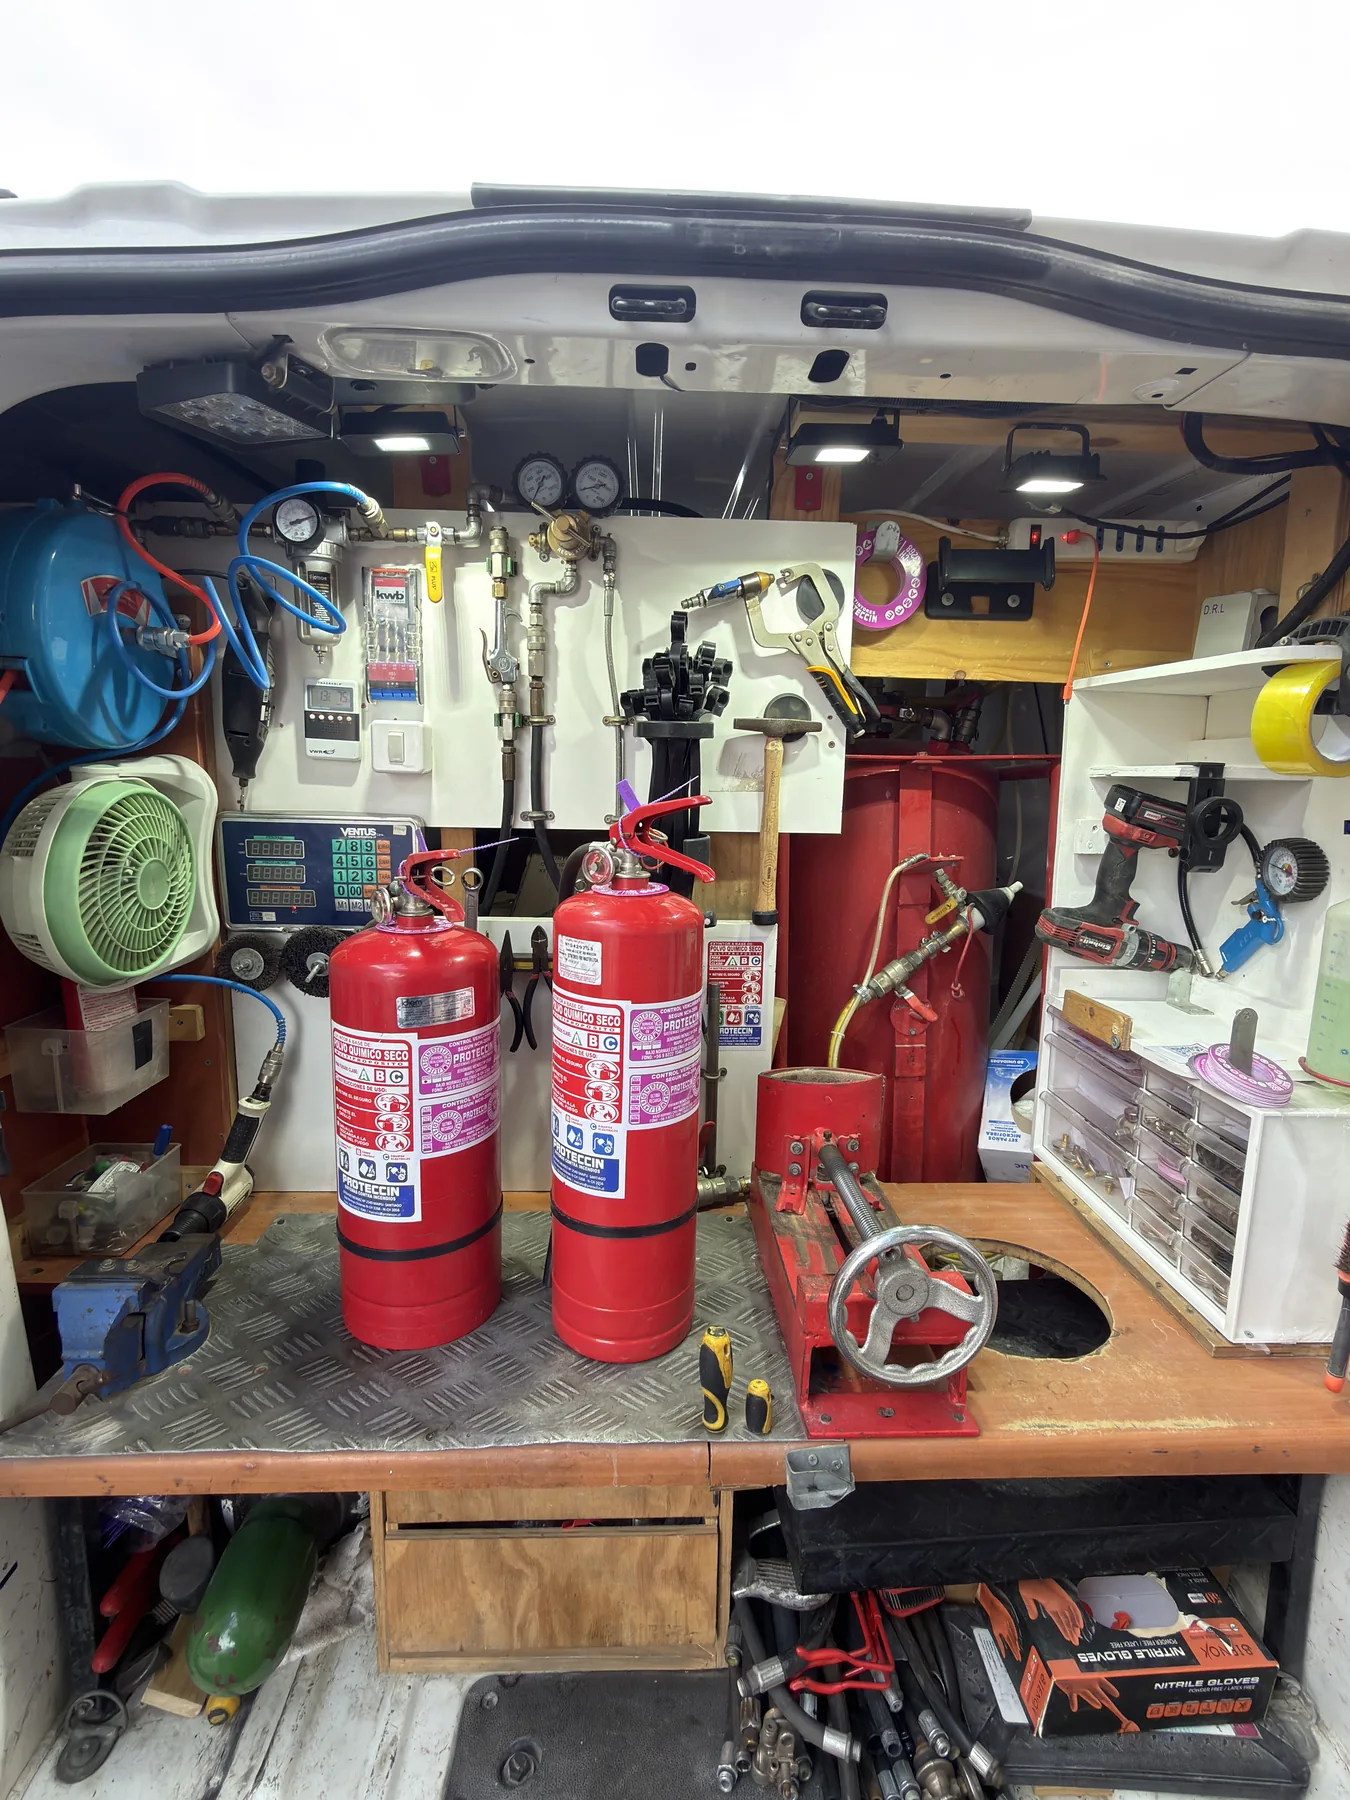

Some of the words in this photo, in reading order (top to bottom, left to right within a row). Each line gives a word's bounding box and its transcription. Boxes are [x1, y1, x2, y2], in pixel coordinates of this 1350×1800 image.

[376, 589, 405, 600] kwb
[340, 827, 377, 837] VENTUS
[335, 840, 343, 852] 7
[350, 840, 358, 852] 8
[364, 840, 373, 852] 9
[335, 855, 344, 867] 4
[350, 855, 359, 867] 5
[365, 856, 374, 866] 6
[336, 870, 344, 882] 1
[351, 870, 359, 882] 2
[366, 871, 374, 882] 3
[337, 885, 345, 896] 0
[349, 885, 362, 897] 00
[337, 901, 347, 909] M1
[351, 901, 362, 909] M2
[751, 956, 761, 966] C
[659, 1005, 682, 1015] CONTROL
[563, 1006, 594, 1024] QUIMICO
[595, 1015, 621, 1027] SECO
[719, 1027, 753, 1035] ROTECCIN
[448, 1037, 472, 1048] CONTROL
[588, 1034, 599, 1048] B
[604, 1036, 618, 1050] C
[348, 1045, 382, 1060] QUIMICO
[383, 1050, 409, 1061] SECO
[453, 1043, 493, 1065] PROTECCIN
[651, 1069, 680, 1081] CONTROL
[441, 1096, 472, 1109] CONTROL
[985, 1131, 1022, 1139] MICROFIBRA
[987, 1135, 1008, 1143] PAÑOS
[553, 1138, 605, 1170] PROTECCIN
[342, 1172, 400, 1197] PROTECCIN
[1205, 1592, 1223, 1604] 50
[1076, 1647, 1132, 1663] GLOVES
[1134, 1645, 1186, 1659] NITRILE
[1153, 1679, 1206, 1691] NITRILE
[1206, 1676, 1260, 1688] GLOVES
